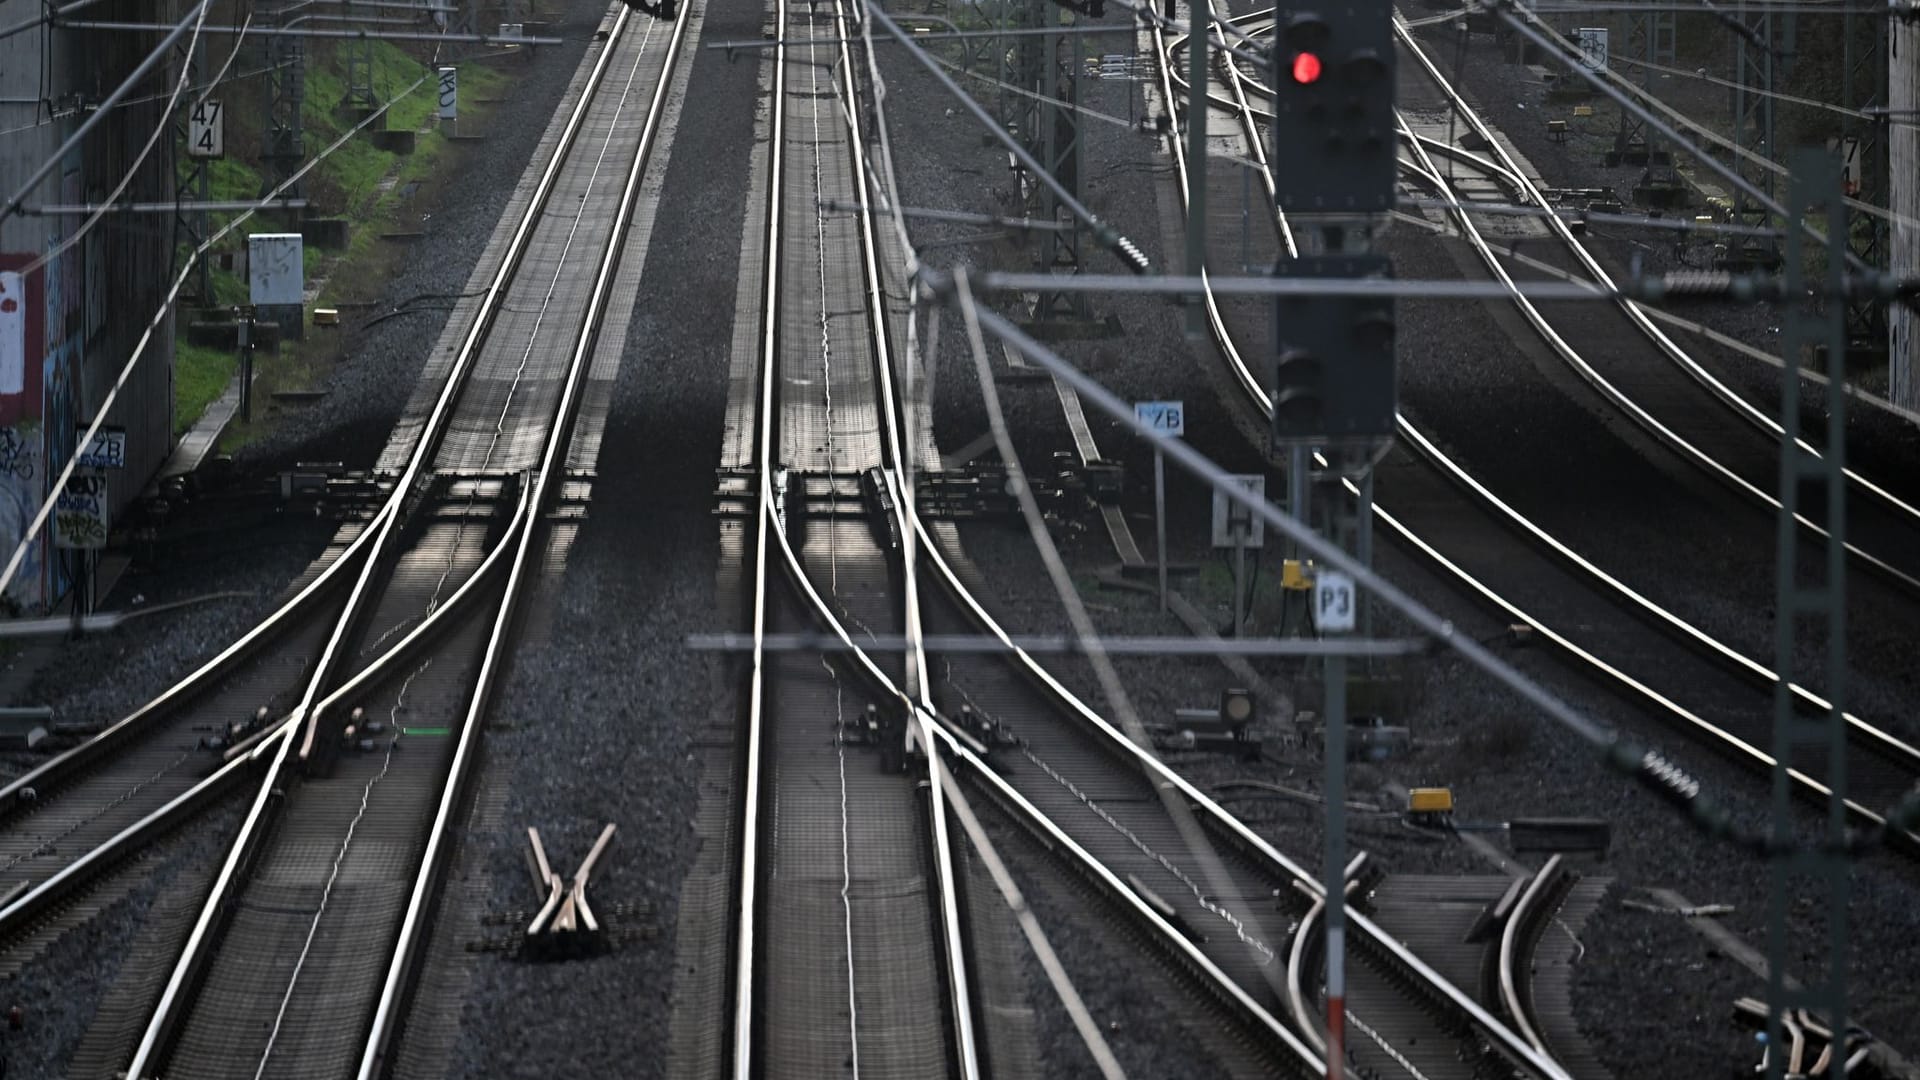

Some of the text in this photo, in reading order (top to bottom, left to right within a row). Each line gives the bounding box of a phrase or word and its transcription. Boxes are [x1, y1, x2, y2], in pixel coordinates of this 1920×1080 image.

[191, 103, 220, 126] 47
[198, 128, 214, 152] 4
[81, 437, 121, 458] ZB
[1321, 587, 1349, 618] P3
